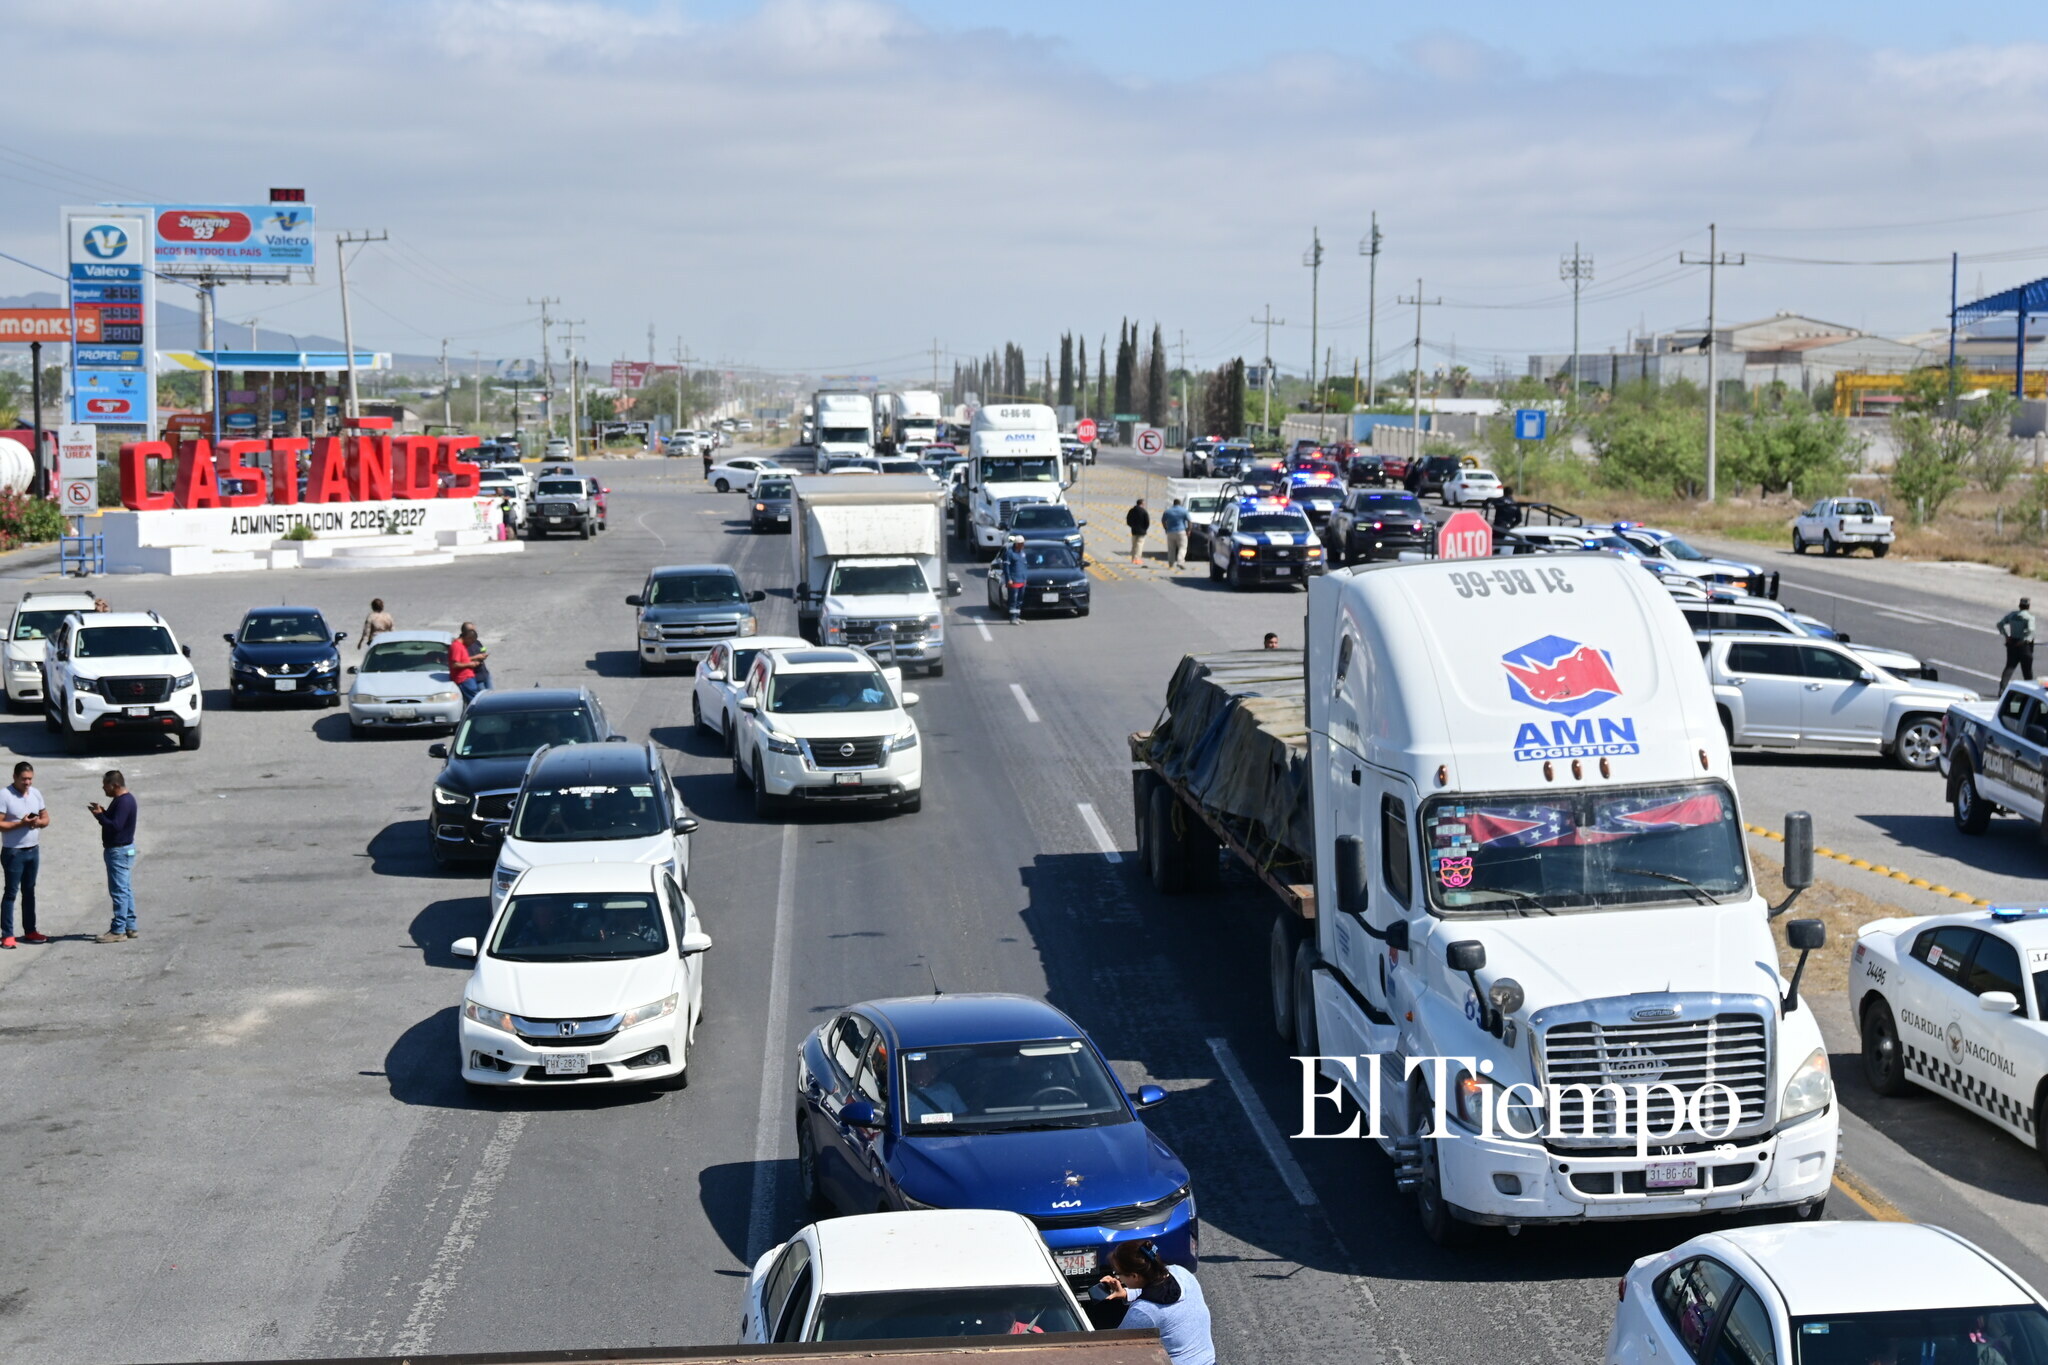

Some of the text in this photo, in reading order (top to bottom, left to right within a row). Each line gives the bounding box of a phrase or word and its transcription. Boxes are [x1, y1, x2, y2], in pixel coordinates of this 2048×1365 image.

[179, 216, 230, 231] Supreme
[193, 227, 214, 239] 93
[265, 235, 309, 246] Valero
[185, 247, 196, 256] EN
[199, 248, 225, 257] TODO
[227, 248, 237, 257] EL
[240, 247, 262, 257] PAÍS
[84, 265, 130, 277] Valero
[1080, 425, 1096, 436] ALTO
[65, 451, 91, 459] UREA
[120, 416, 480, 511] CASTAÑOS
[231, 512, 343, 535] ADMINISTRACION
[1444, 529, 1487, 559] ALTO
[1534, 567, 1575, 594] 31
[1514, 718, 1637, 749] AMN
[1518, 744, 1636, 760] LOGISTICA
[1901, 1009, 2016, 1077] GUARDIA NACIONAL
[1650, 1167, 1693, 1181] 31-BG-6G
[1052, 1200, 1081, 1208] KIA
